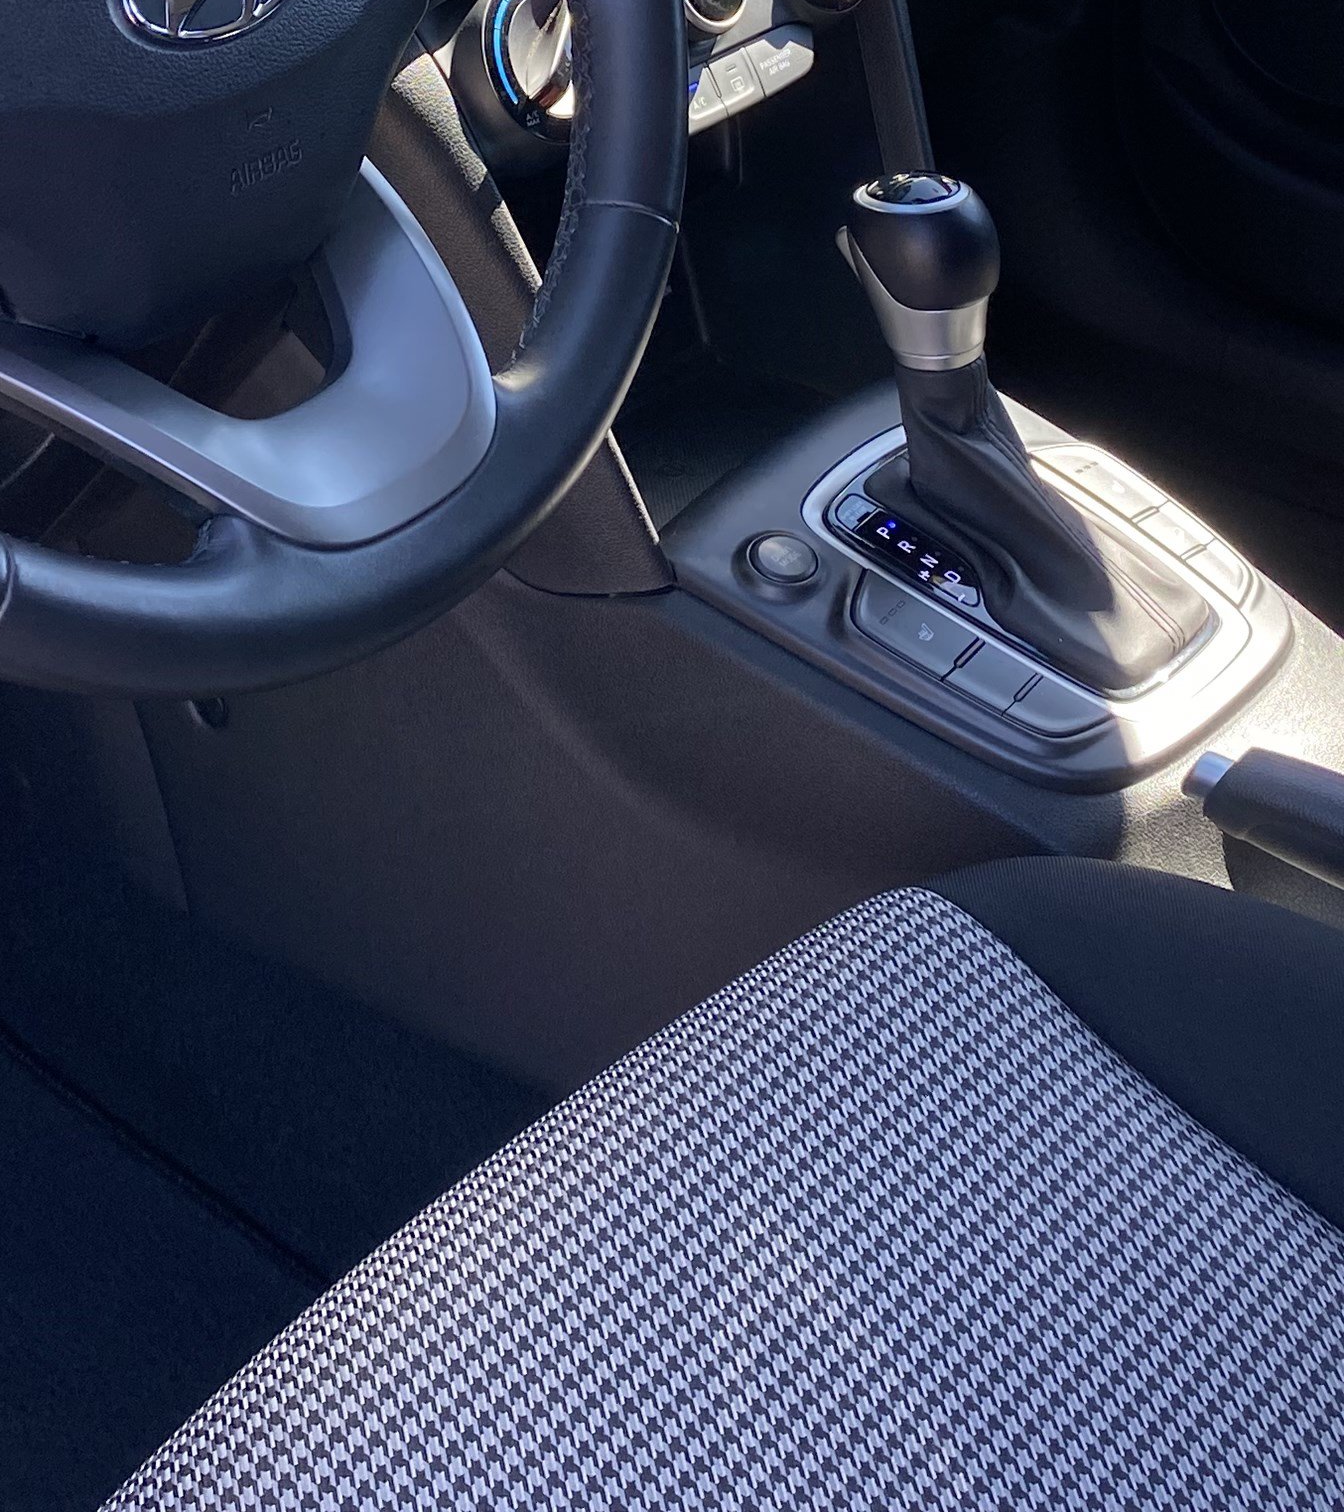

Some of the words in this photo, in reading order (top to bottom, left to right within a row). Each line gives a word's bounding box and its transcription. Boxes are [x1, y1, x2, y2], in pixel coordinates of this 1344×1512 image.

[693, 96, 707, 111] A/C
[876, 526, 892, 540] P
[897, 540, 917, 554] R
[919, 553, 940, 569] N
[943, 569, 962, 585] D
